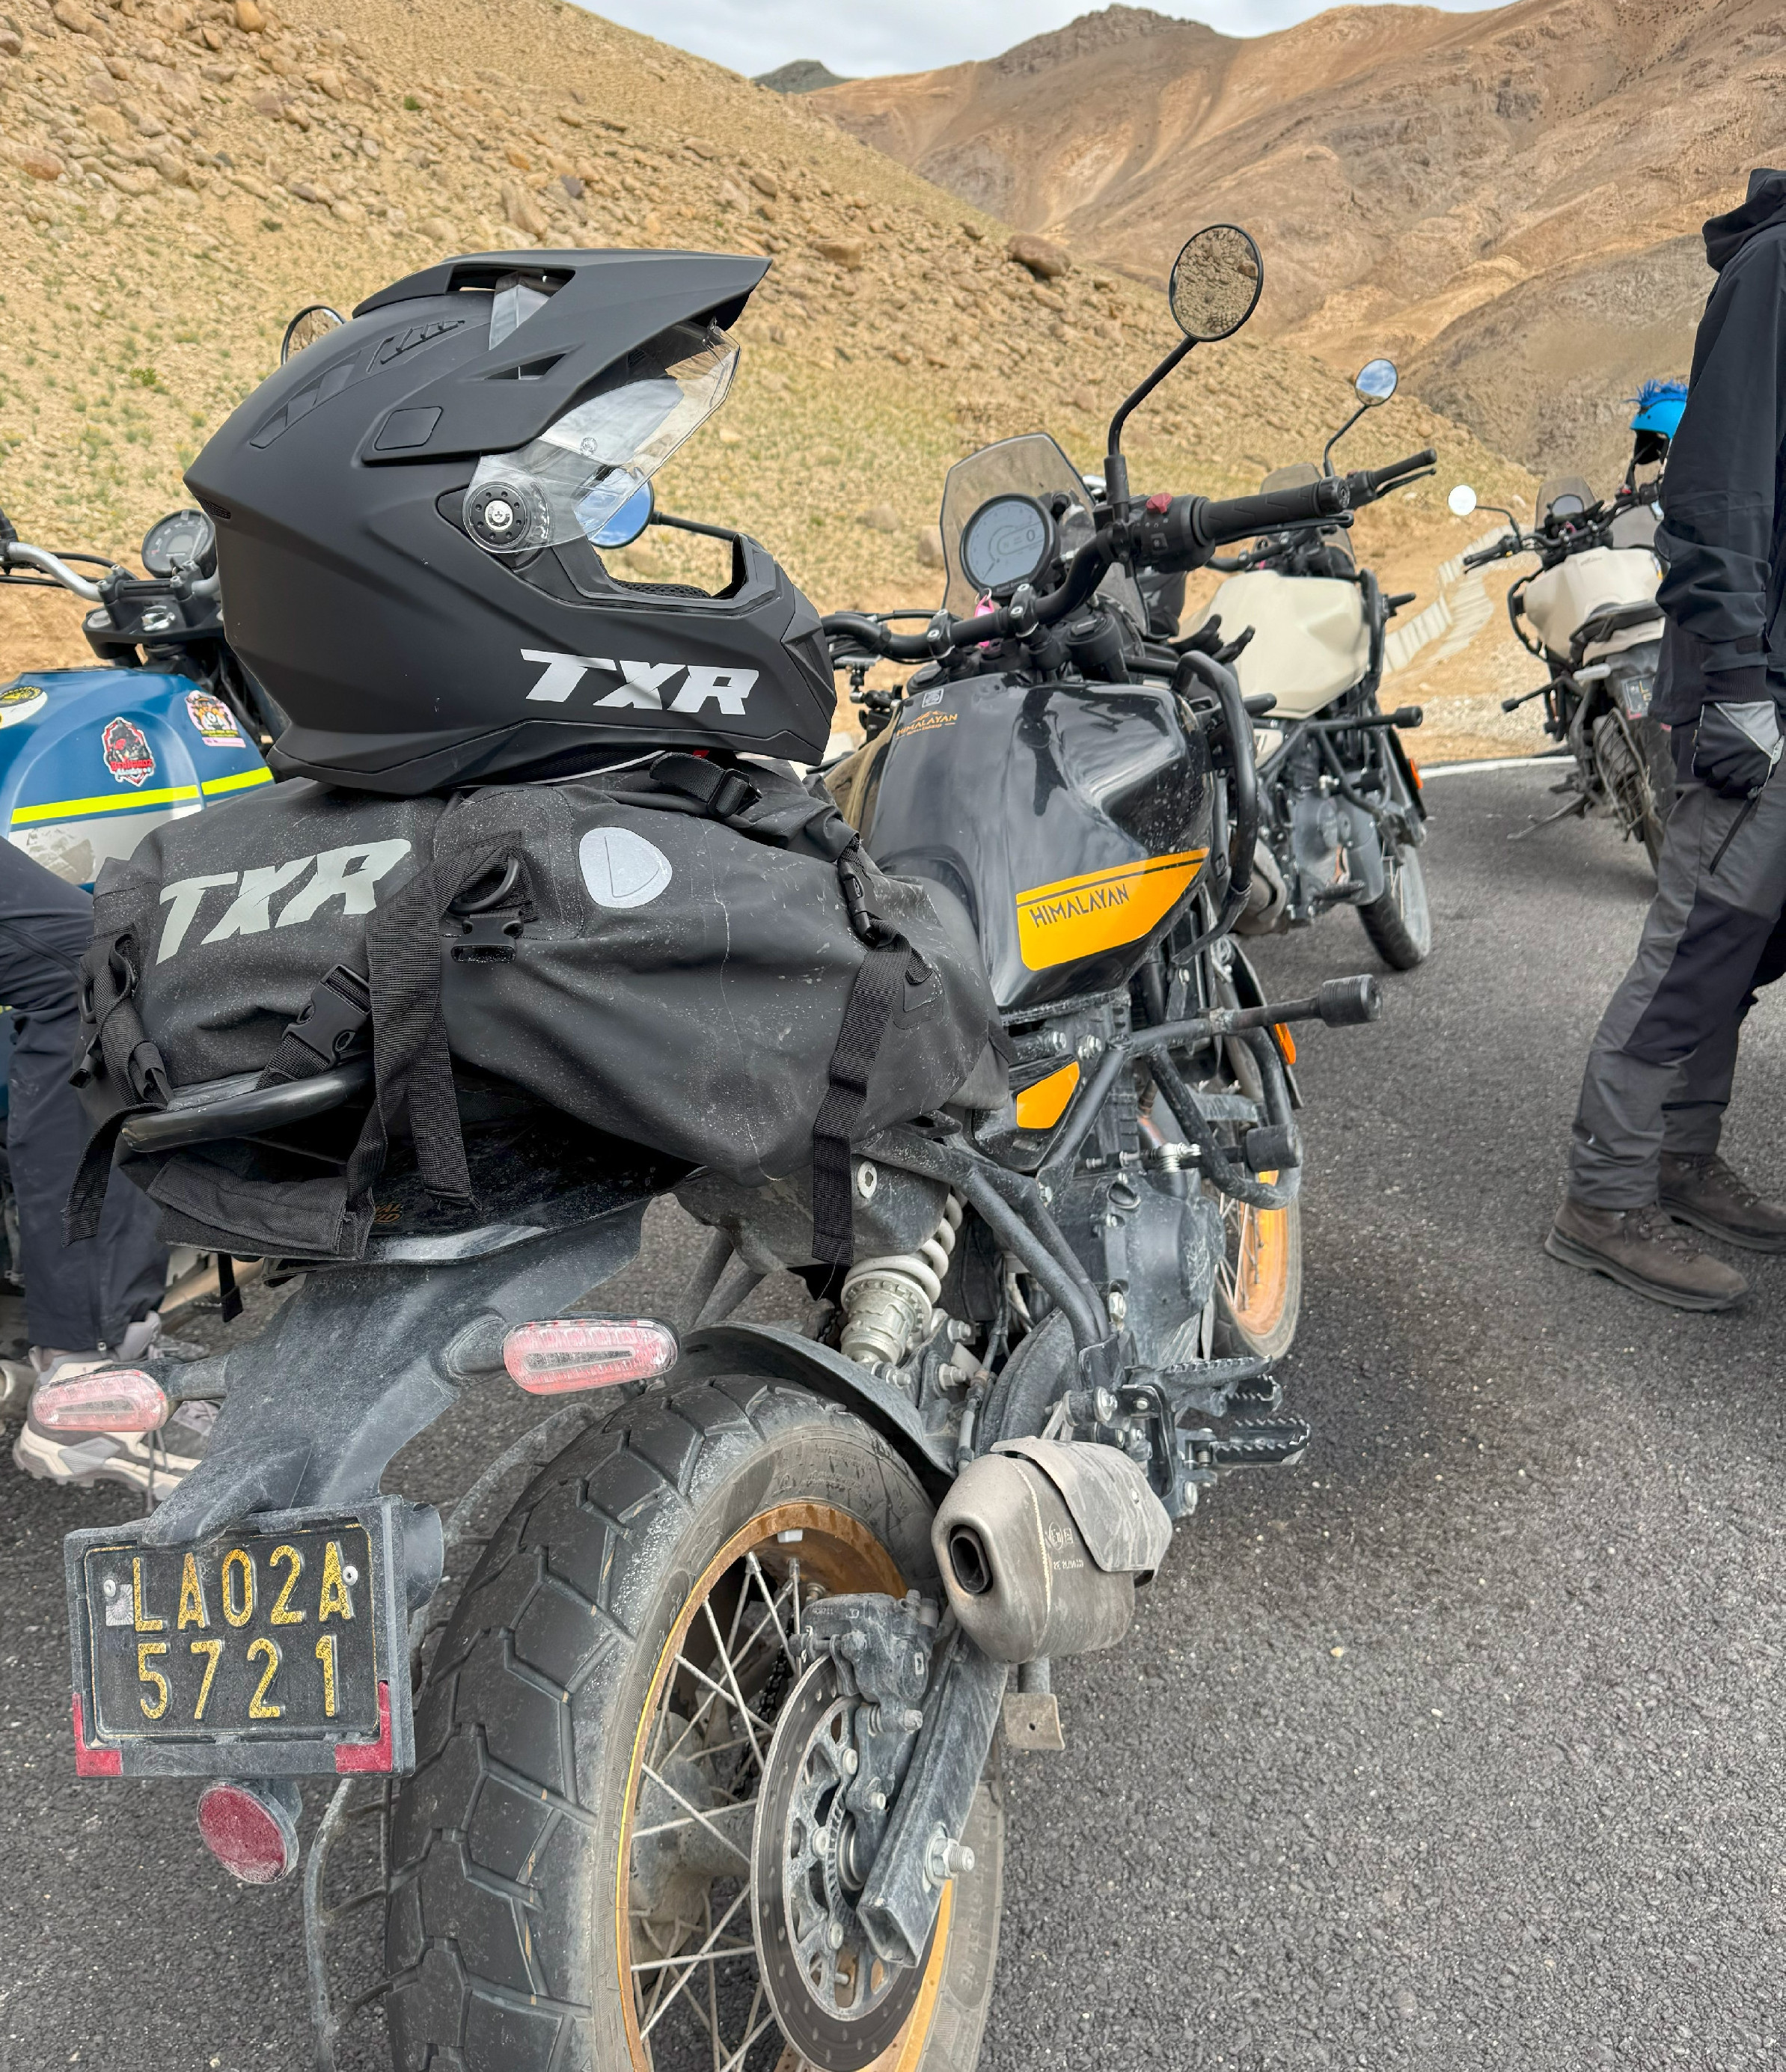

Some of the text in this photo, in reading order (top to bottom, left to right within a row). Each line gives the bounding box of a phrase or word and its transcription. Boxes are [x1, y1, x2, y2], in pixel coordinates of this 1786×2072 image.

[520, 648, 759, 715] TXR
[896, 713, 958, 737] HIMALAYAN
[156, 838, 412, 966] TXR
[1029, 883, 1130, 929] HIMALAYAN
[376, 1203, 403, 1212] YAL
[132, 1541, 352, 1632] LA02A
[138, 1635, 336, 1719] 5721
